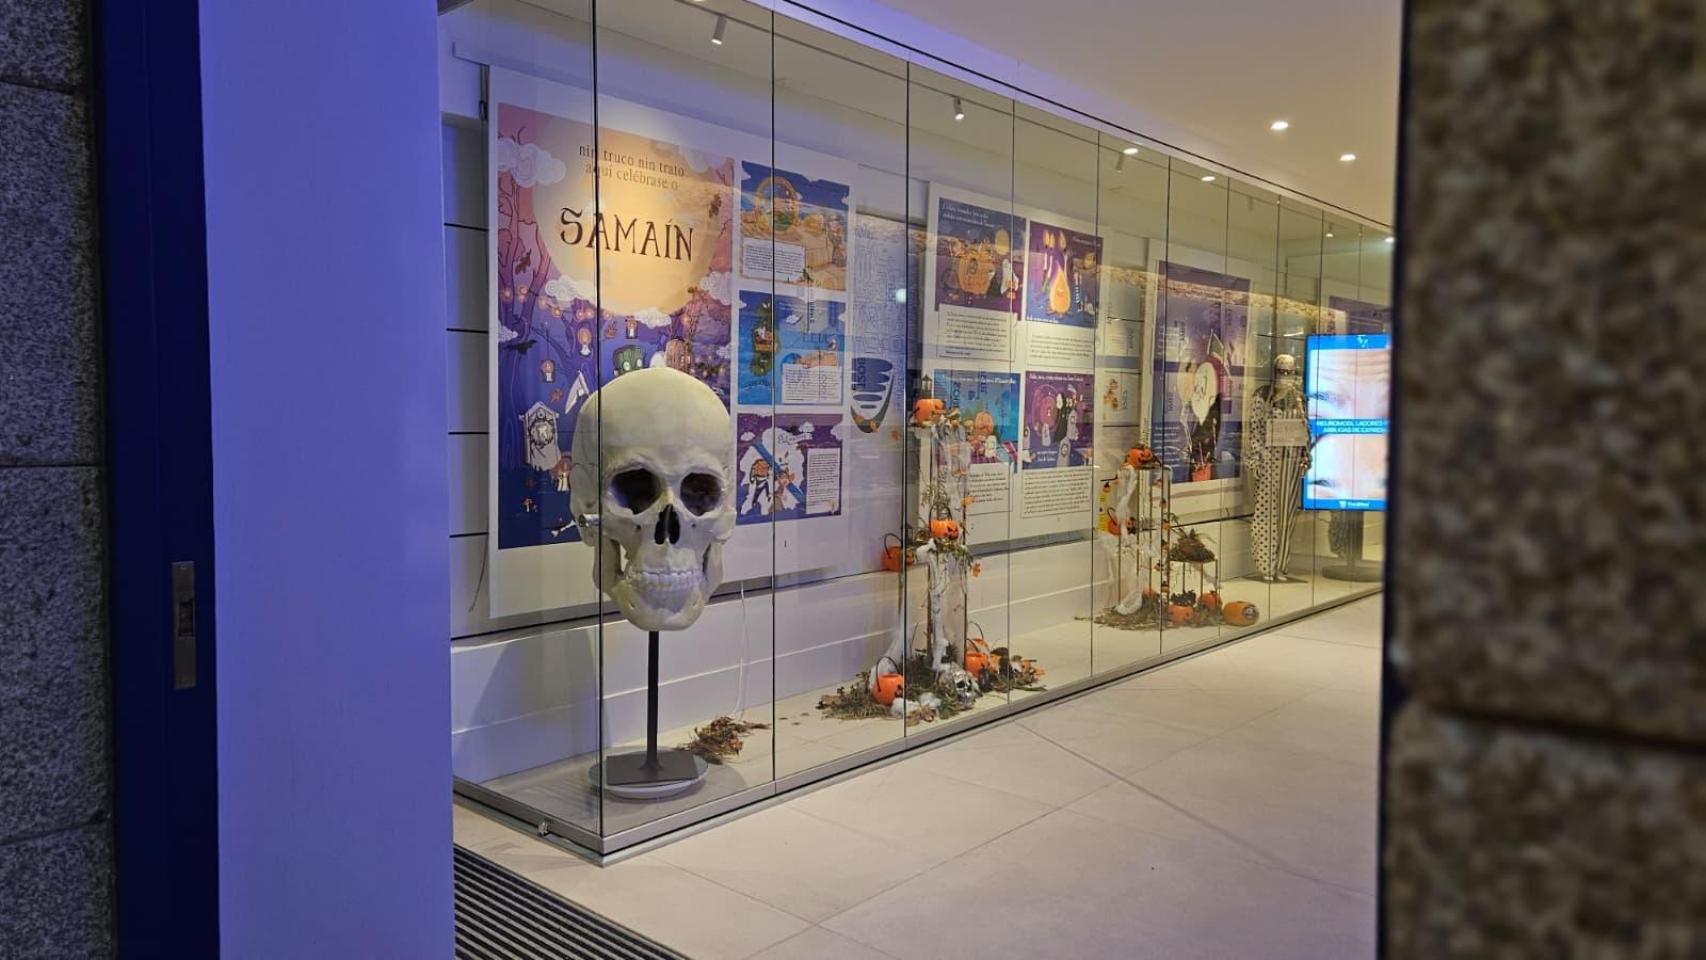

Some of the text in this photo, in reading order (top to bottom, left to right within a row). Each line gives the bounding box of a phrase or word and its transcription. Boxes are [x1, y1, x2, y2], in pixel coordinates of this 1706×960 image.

[604, 149, 635, 165] truco
[638, 157, 656, 171] nin
[660, 161, 685, 176] trato
[616, 168, 668, 188] celébrase
[671, 180, 679, 190] o
[560, 207, 694, 262] SAMAÍN
